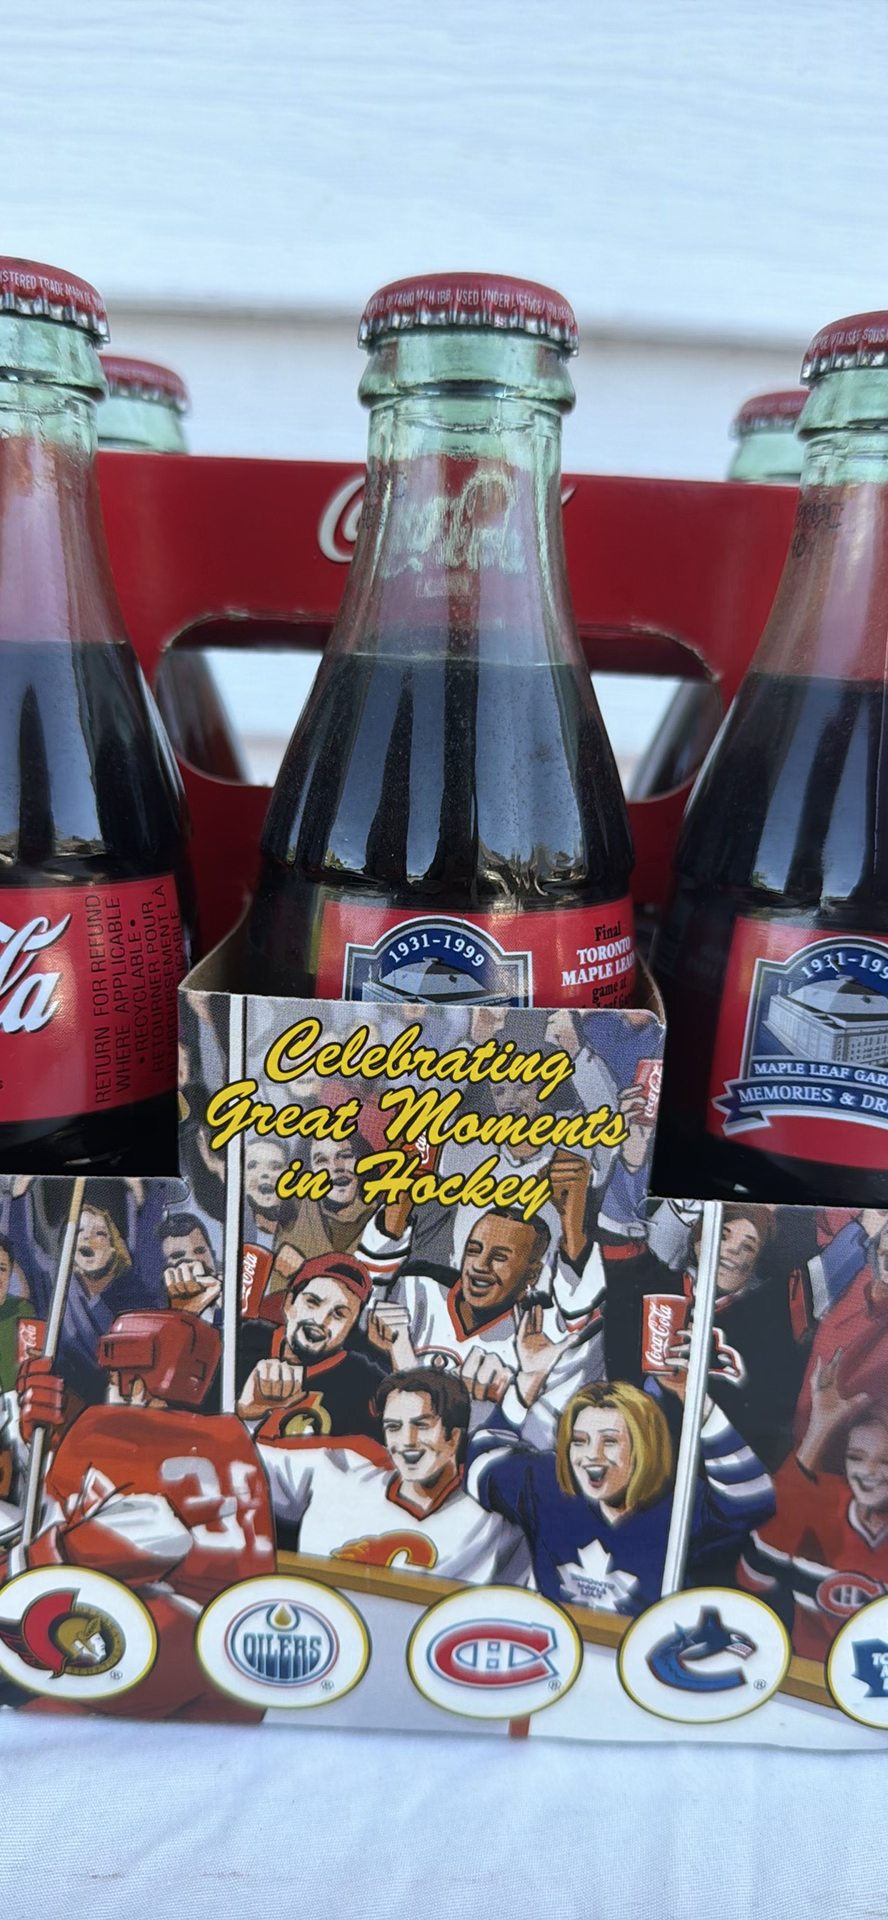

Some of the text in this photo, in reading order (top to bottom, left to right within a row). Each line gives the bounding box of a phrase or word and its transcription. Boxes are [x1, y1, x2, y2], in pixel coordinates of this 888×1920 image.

[38, 276, 64, 296] TRADE
[416, 288, 435, 305] M4H
[456, 288, 479, 306] USED
[480, 288, 509, 308] UNDER
[861, 328, 885, 343] SOUS
[594, 921, 622, 941] Final
[389, 933, 485, 967] 1931-1999
[576, 935, 632, 965] TORONTO
[142, 901, 164, 1073] RETOURNER POUR
[561, 962, 614, 987] MAPLE
[85, 894, 111, 1103] RETURN FOR REFUND
[105, 897, 131, 1093] WHERE APPLICABLE
[128, 931, 148, 1053] RECYCLABLE
[592, 981, 618, 1004] game
[264, 1016, 575, 1100] Celebrating
[753, 1062, 805, 1075] MAPLE
[809, 1060, 850, 1078] LEAF
[737, 1085, 833, 1103] MEMORIES
[839, 1091, 854, 1106] &
[204, 1079, 364, 1152] Great
[379, 1087, 630, 1149] Moments
[275, 1149, 553, 1222] in Hockey
[243, 1631, 322, 1680] OILERS
